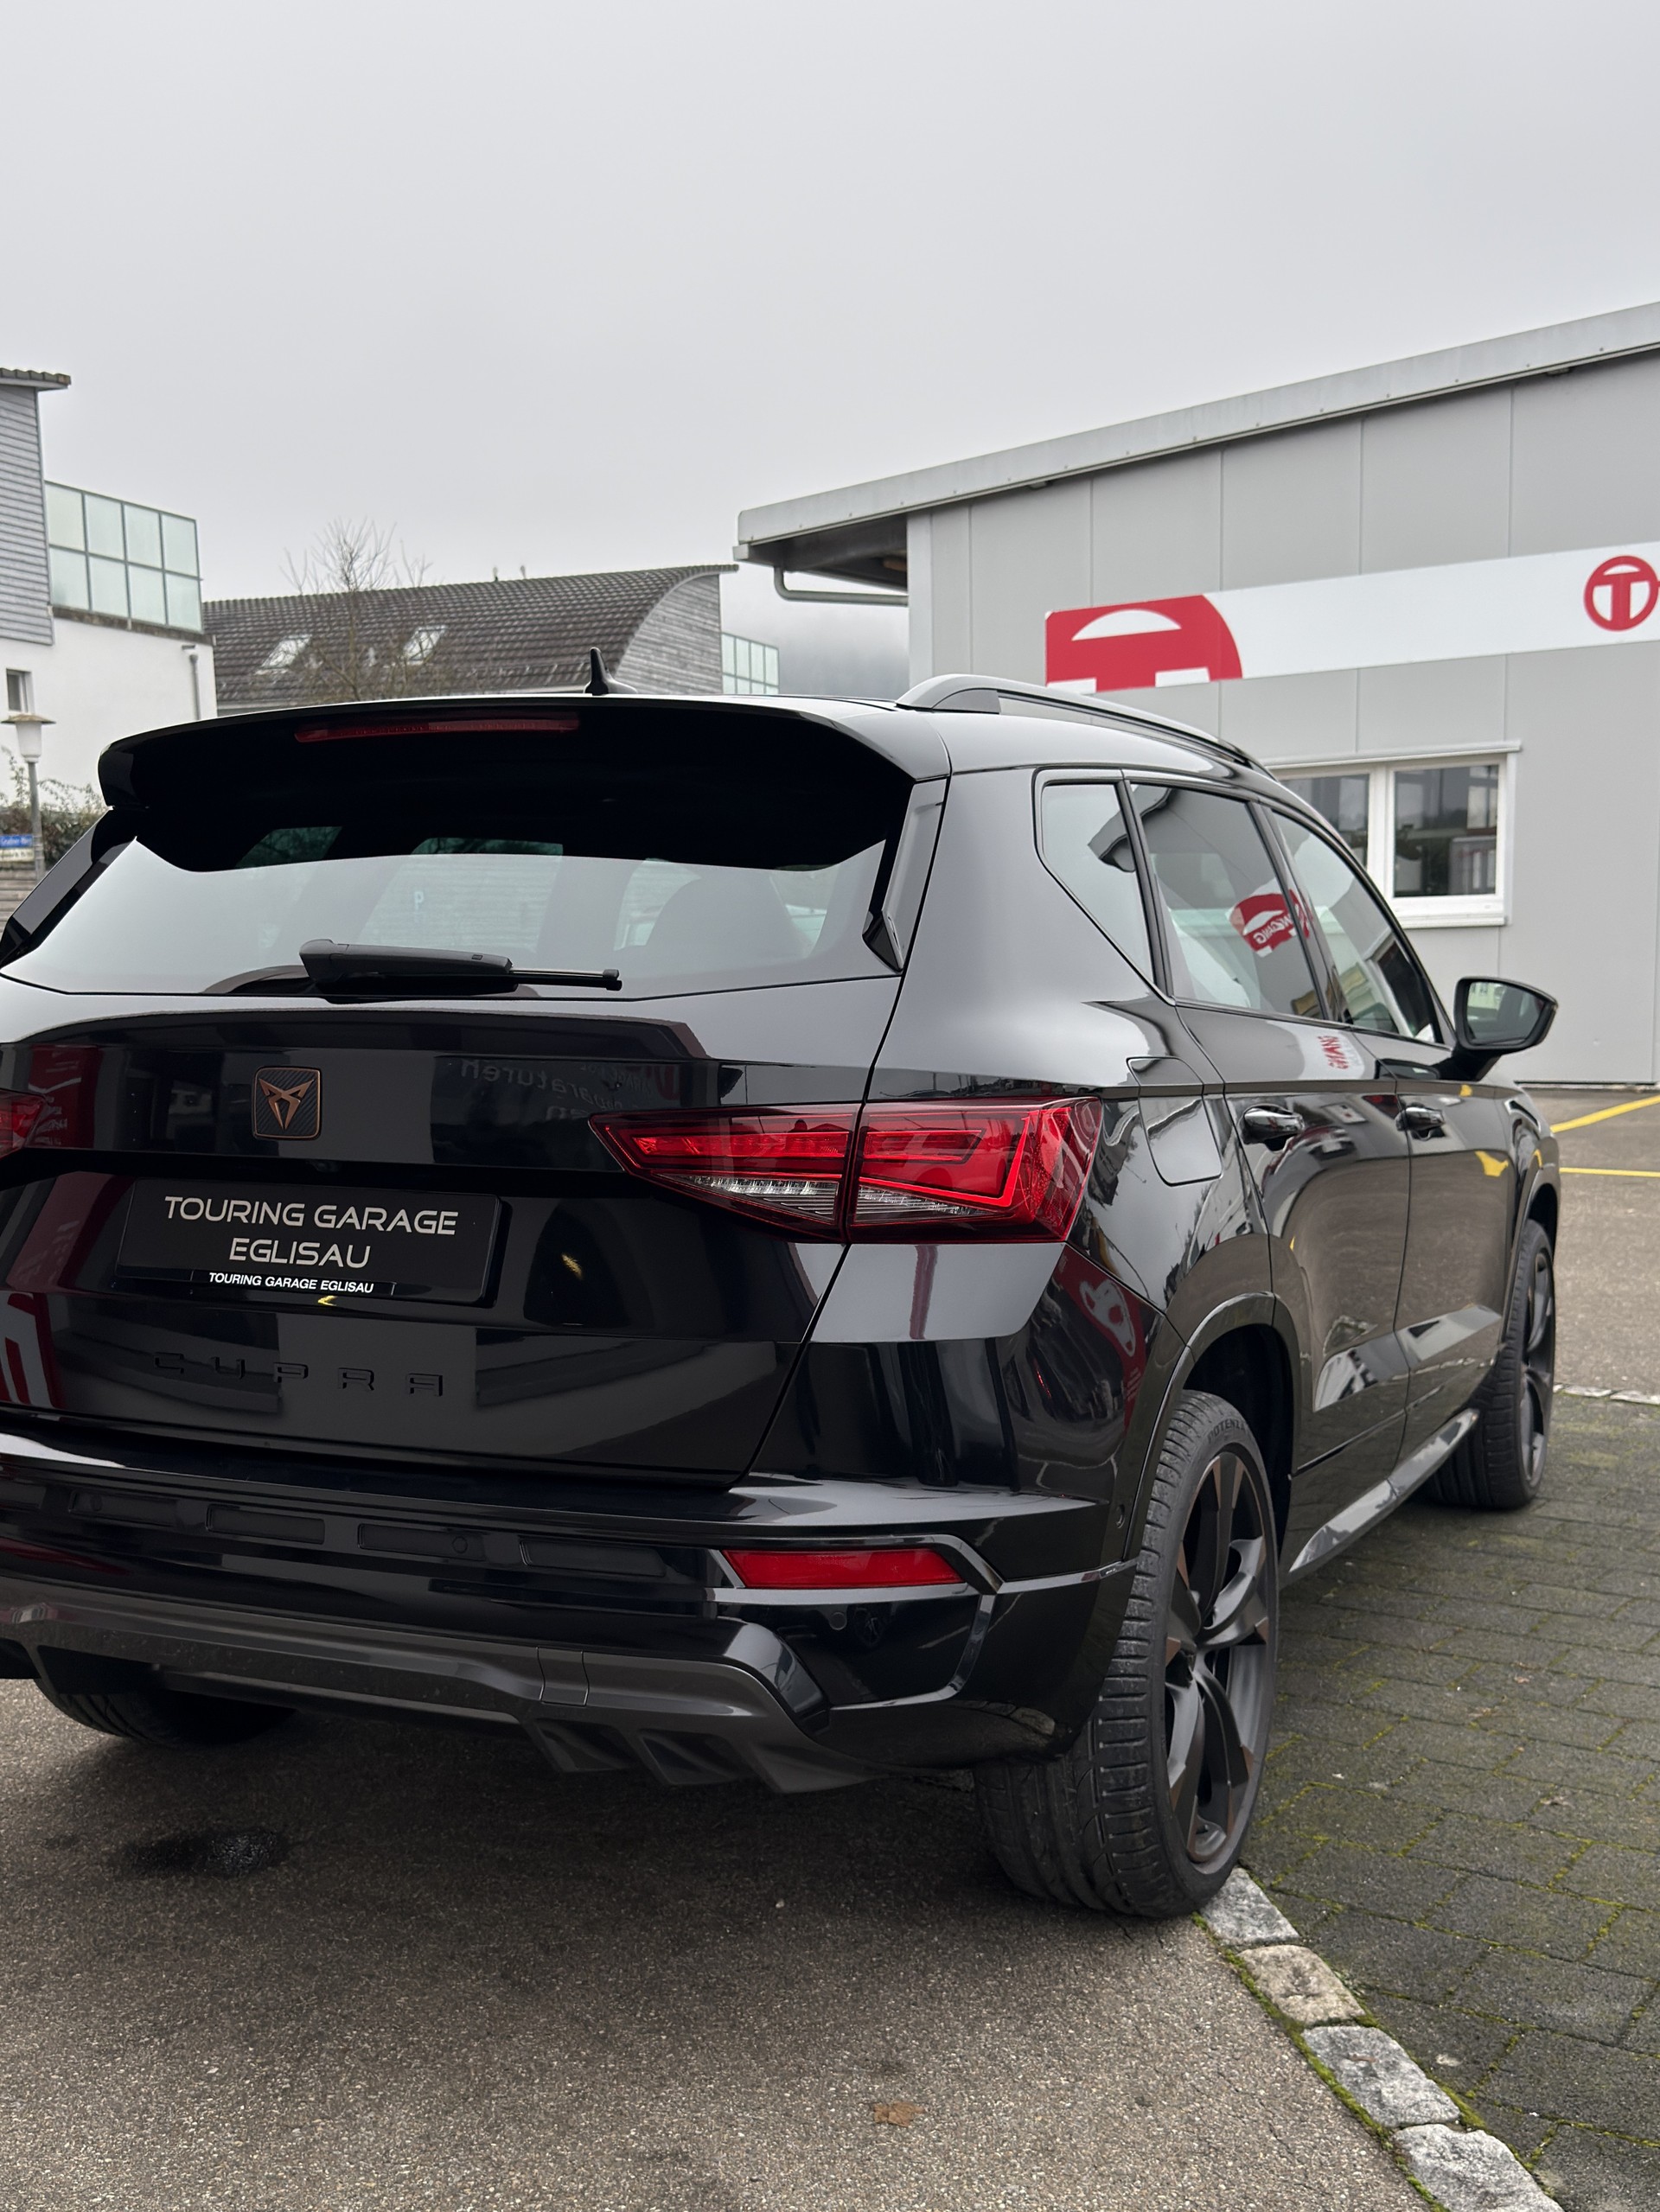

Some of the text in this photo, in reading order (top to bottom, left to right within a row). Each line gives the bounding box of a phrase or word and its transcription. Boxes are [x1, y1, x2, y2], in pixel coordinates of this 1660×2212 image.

[164, 1195, 459, 1235] TOURING GARAGE
[229, 1237, 371, 1269] EGLISAU
[208, 1272, 374, 1293] TOURING GARAGE EGLISAU
[153, 1352, 443, 1397] CUPRA
